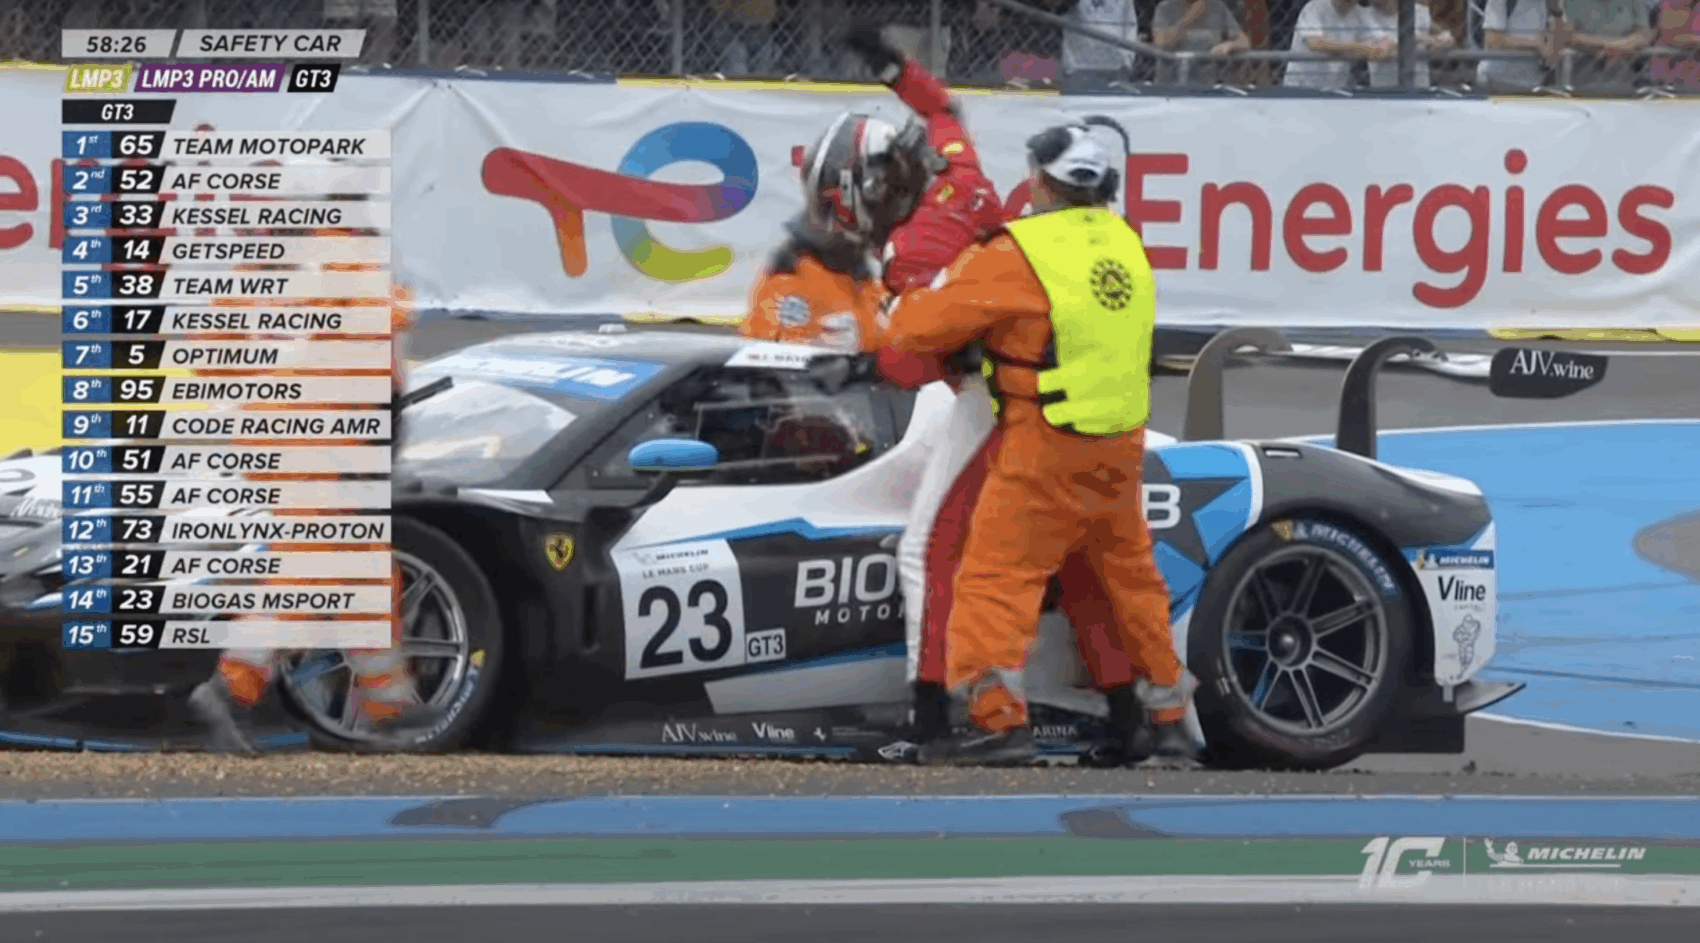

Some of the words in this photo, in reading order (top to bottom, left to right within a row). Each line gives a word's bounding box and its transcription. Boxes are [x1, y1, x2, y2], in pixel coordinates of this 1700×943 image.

[1508, 349, 1595, 380] AJV.wine
[794, 553, 897, 608] BIO
[1437, 575, 1487, 601] Vline
[637, 578, 733, 669] 23
[814, 603, 906, 625] MOTO
[748, 634, 784, 657] GT3
[752, 722, 795, 739] Vline
